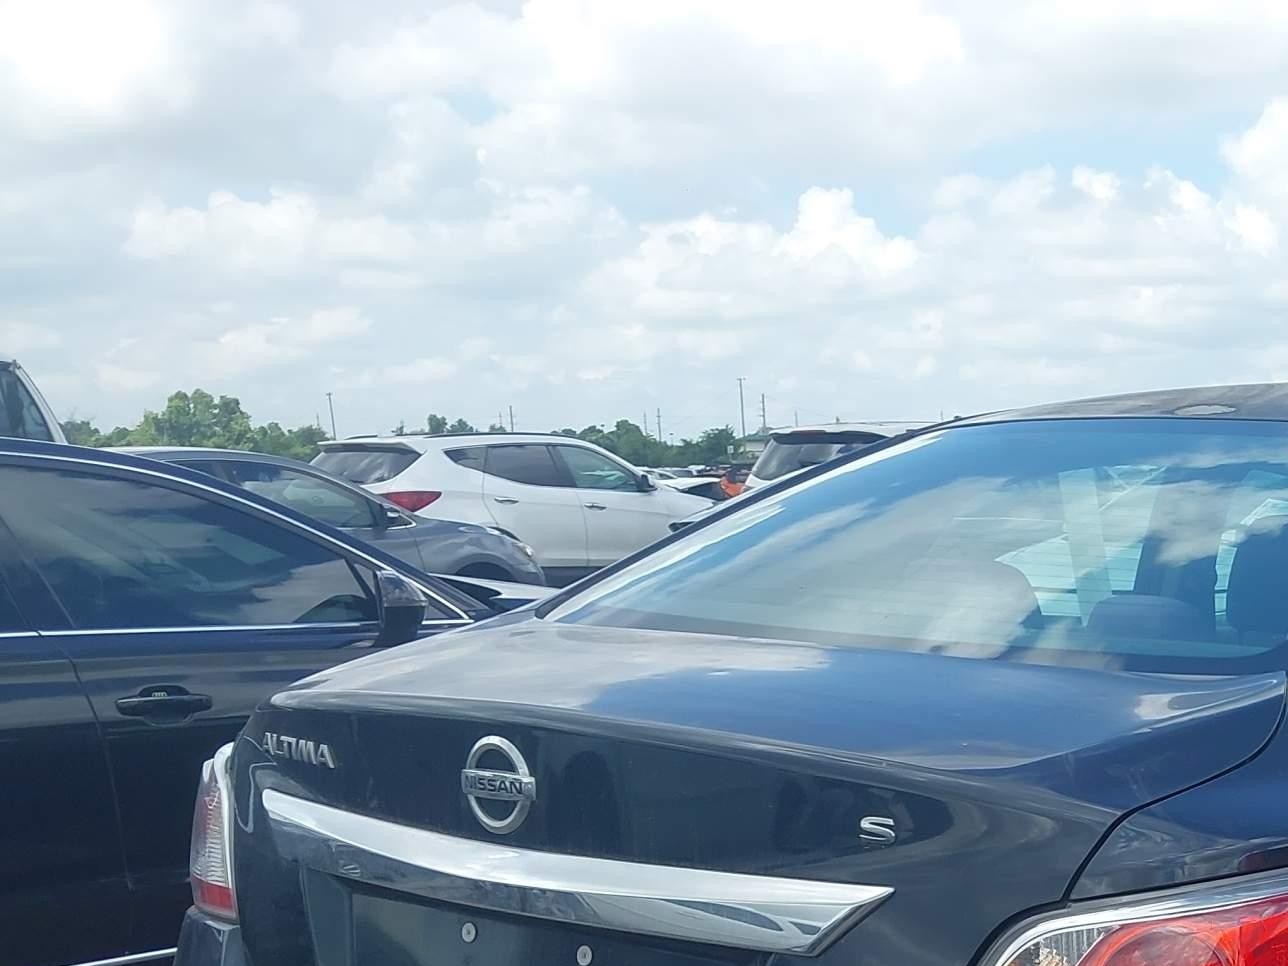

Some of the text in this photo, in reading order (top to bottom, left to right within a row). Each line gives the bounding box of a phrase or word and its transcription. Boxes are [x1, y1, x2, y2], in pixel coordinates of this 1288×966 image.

[263, 731, 335, 769] ALTIMA
[465, 774, 523, 795] NISSAN
[859, 816, 896, 845] S
